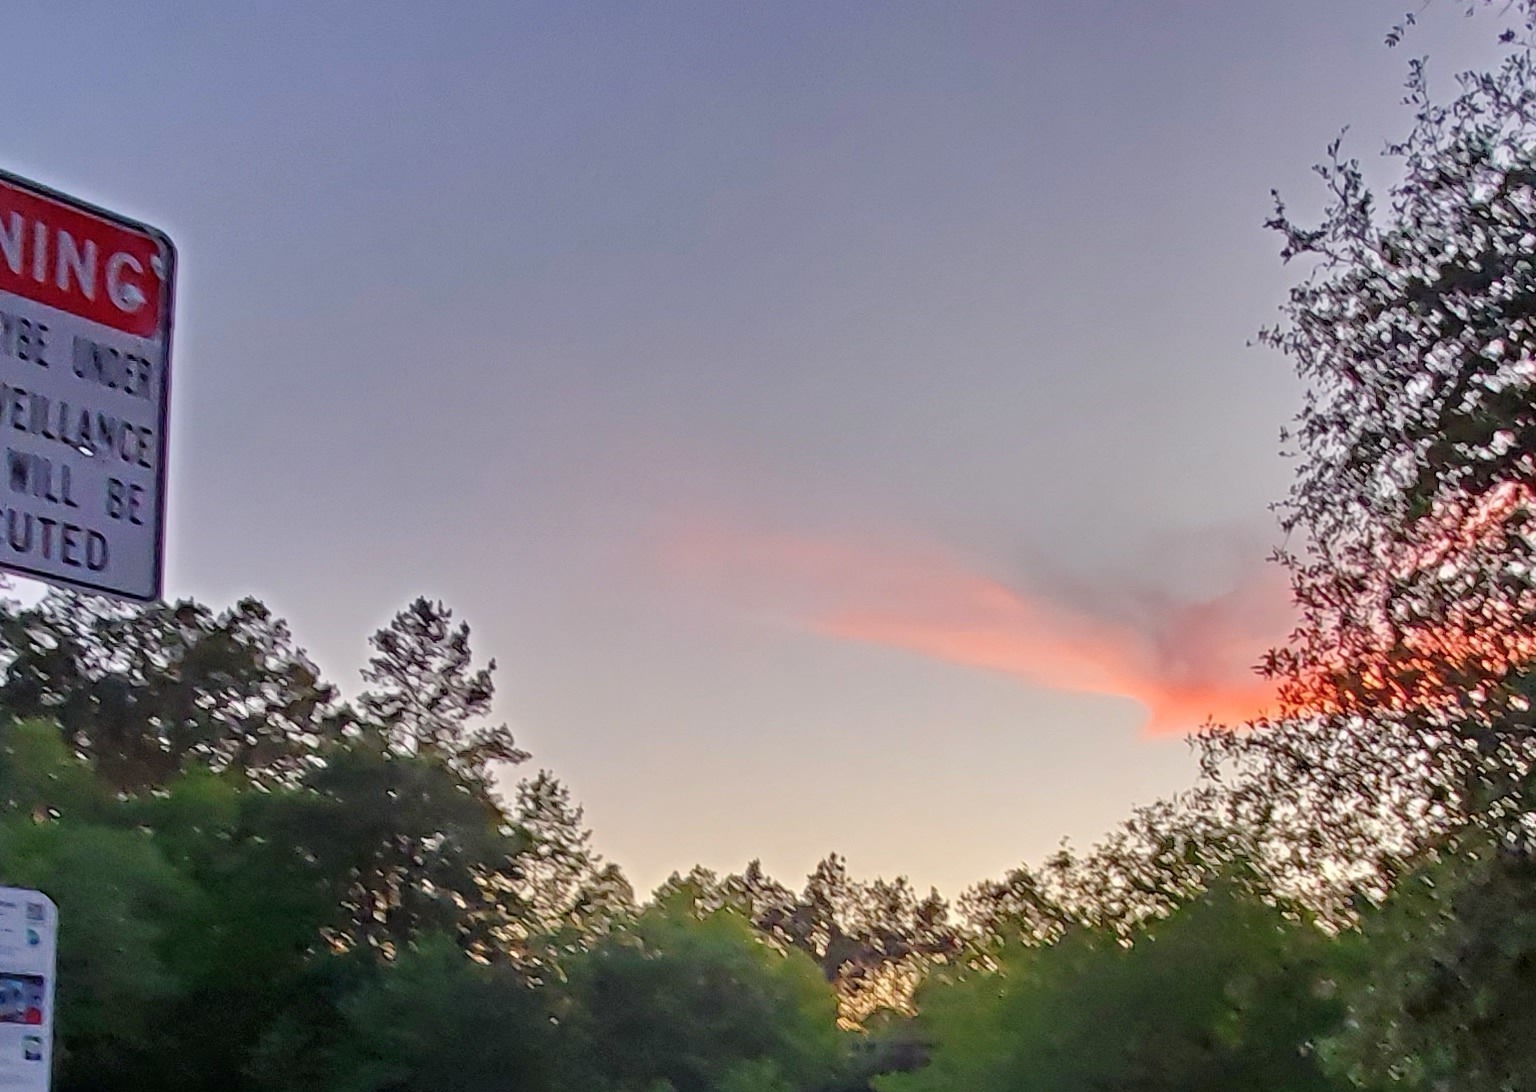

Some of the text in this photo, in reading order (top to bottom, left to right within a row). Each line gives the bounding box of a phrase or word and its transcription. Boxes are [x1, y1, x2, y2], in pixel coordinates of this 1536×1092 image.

[72, 335, 151, 400] UNDER
[7, 446, 78, 508] WILL
[107, 477, 146, 526] BE
